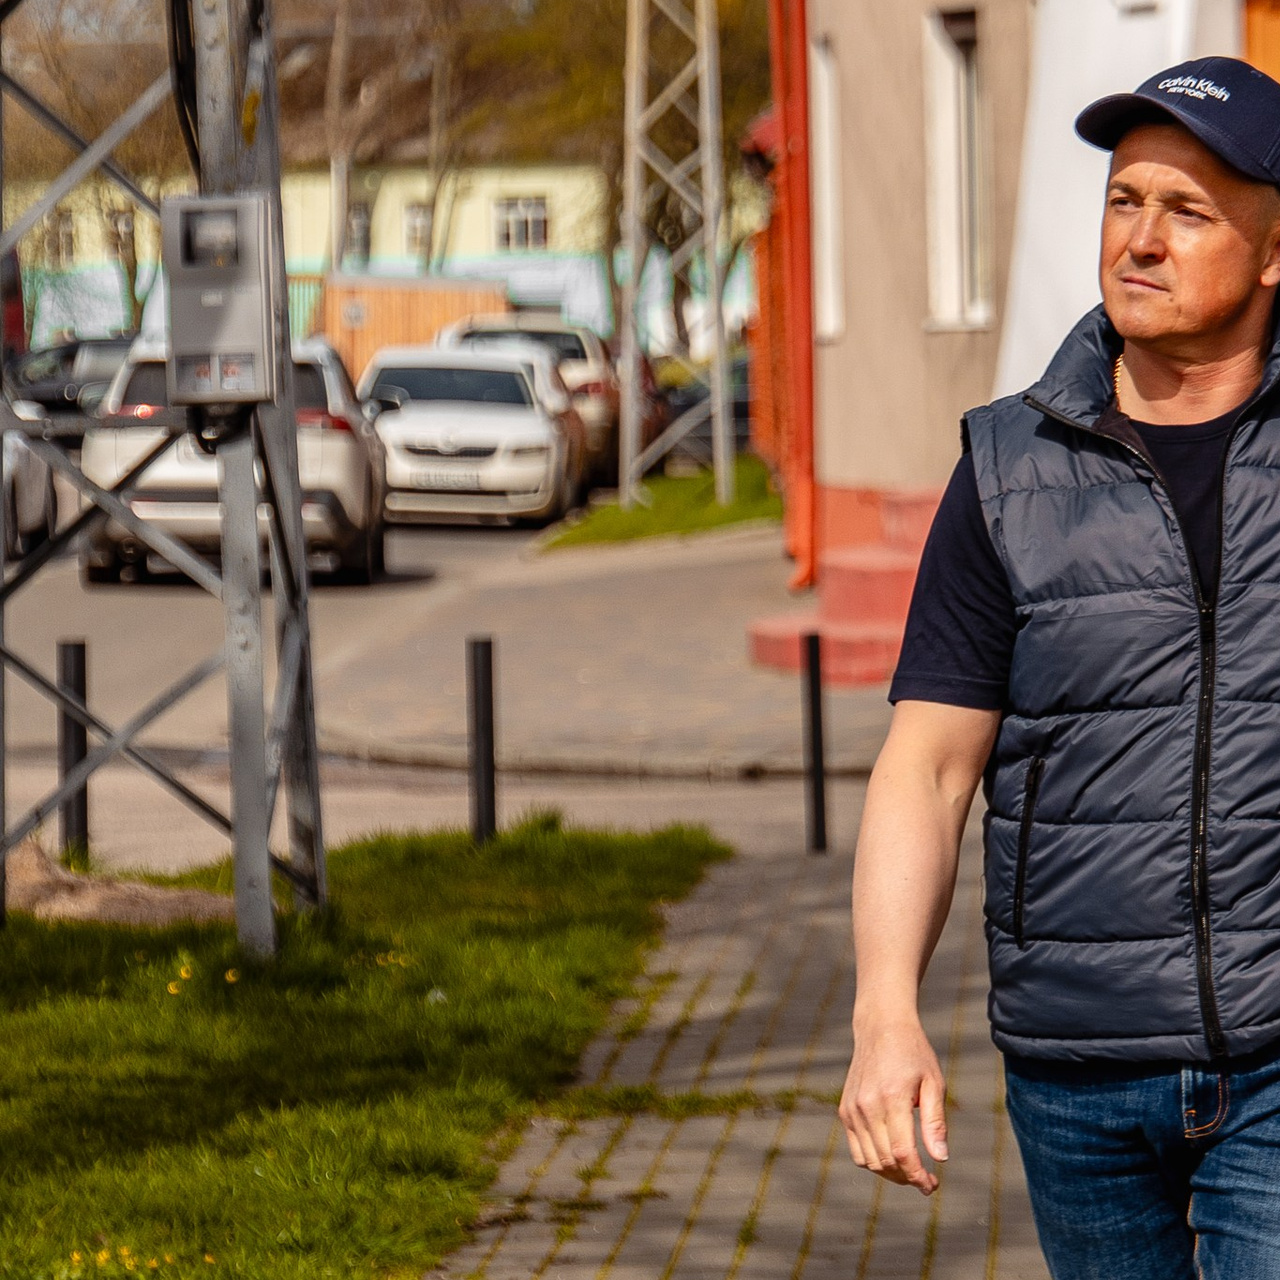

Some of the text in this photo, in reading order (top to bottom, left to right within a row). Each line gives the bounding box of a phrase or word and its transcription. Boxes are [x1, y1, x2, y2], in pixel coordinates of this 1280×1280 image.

[1158, 75, 1231, 101] Calvin Klein
[1184, 87, 1207, 100] YORK
